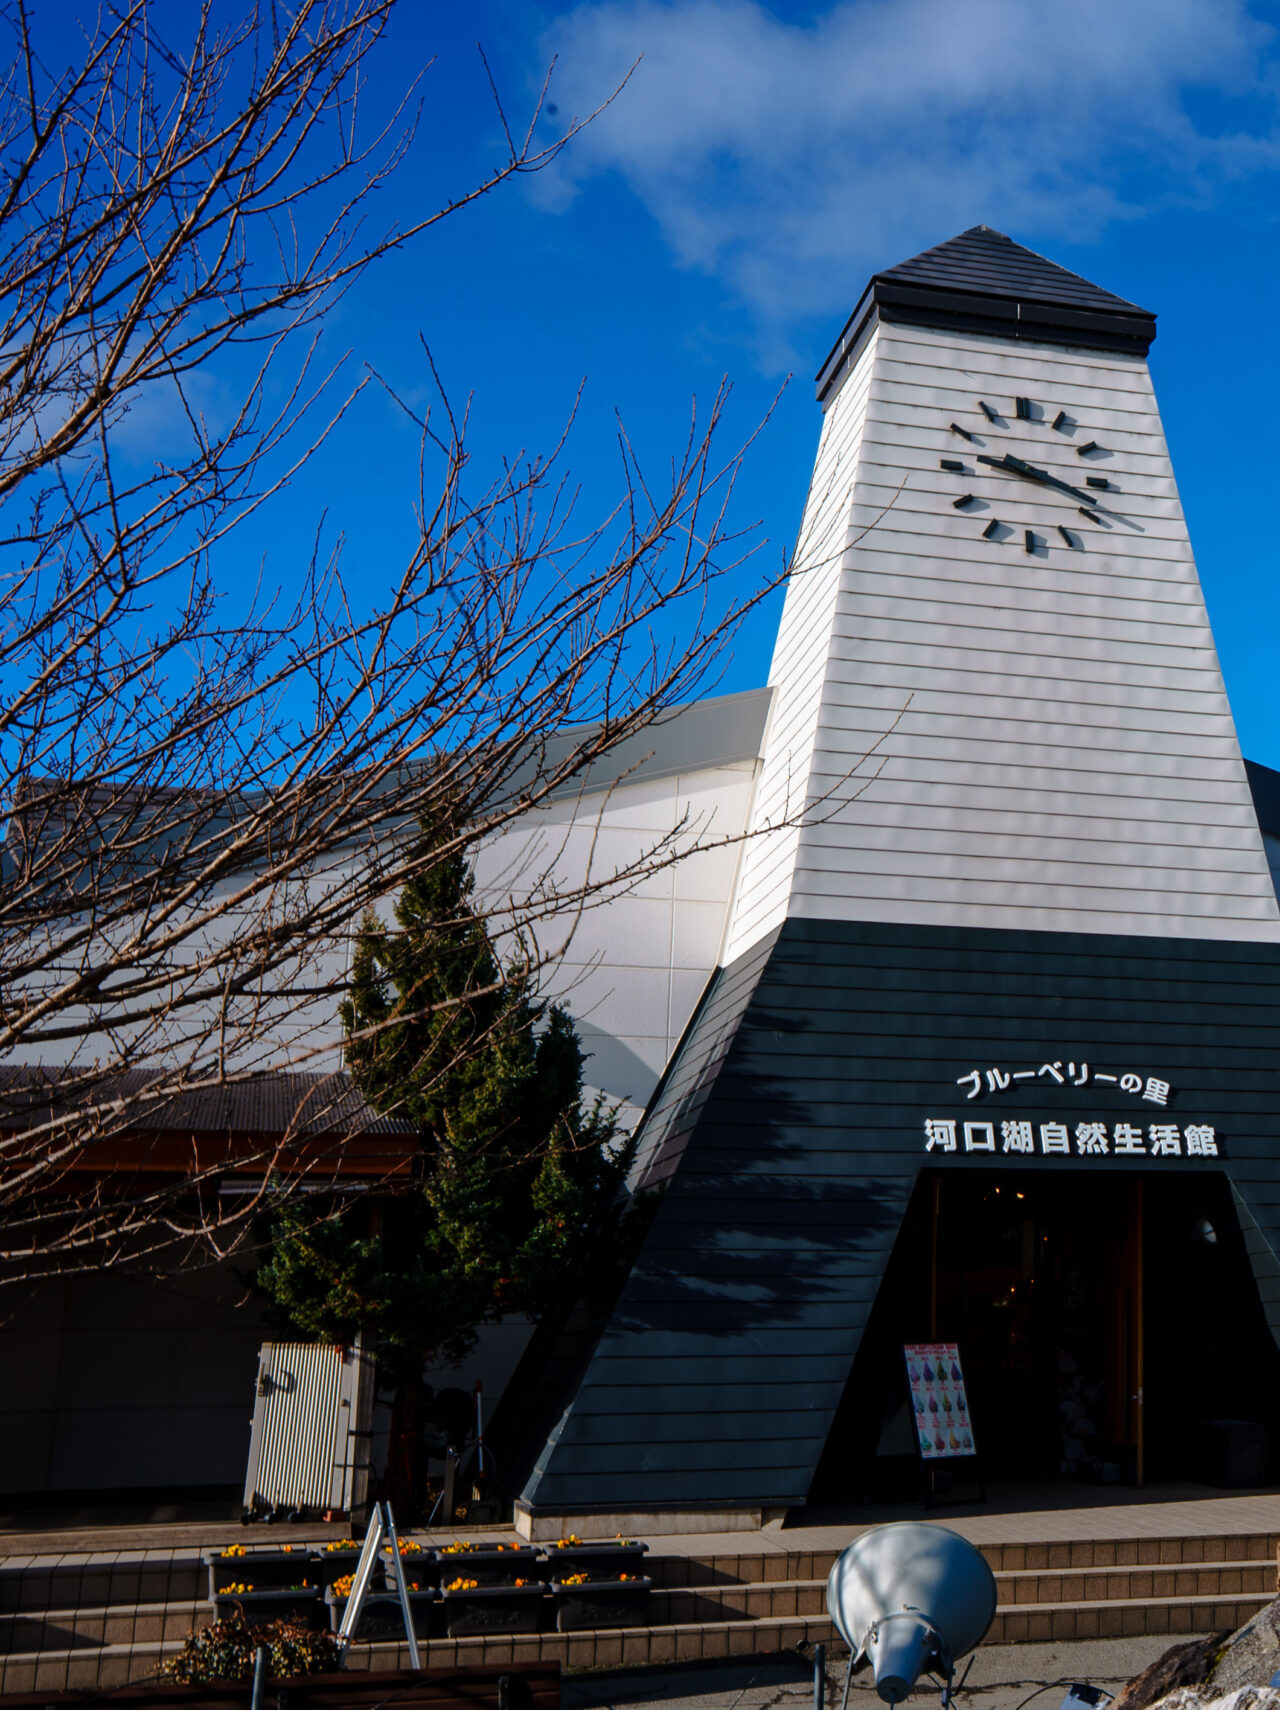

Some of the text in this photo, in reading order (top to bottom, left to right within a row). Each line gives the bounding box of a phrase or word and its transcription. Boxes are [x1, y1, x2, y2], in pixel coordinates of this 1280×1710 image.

[957, 1061, 1171, 1106] ブルーベリーの里
[924, 1119, 1219, 1157] 河口湖自然生活館
